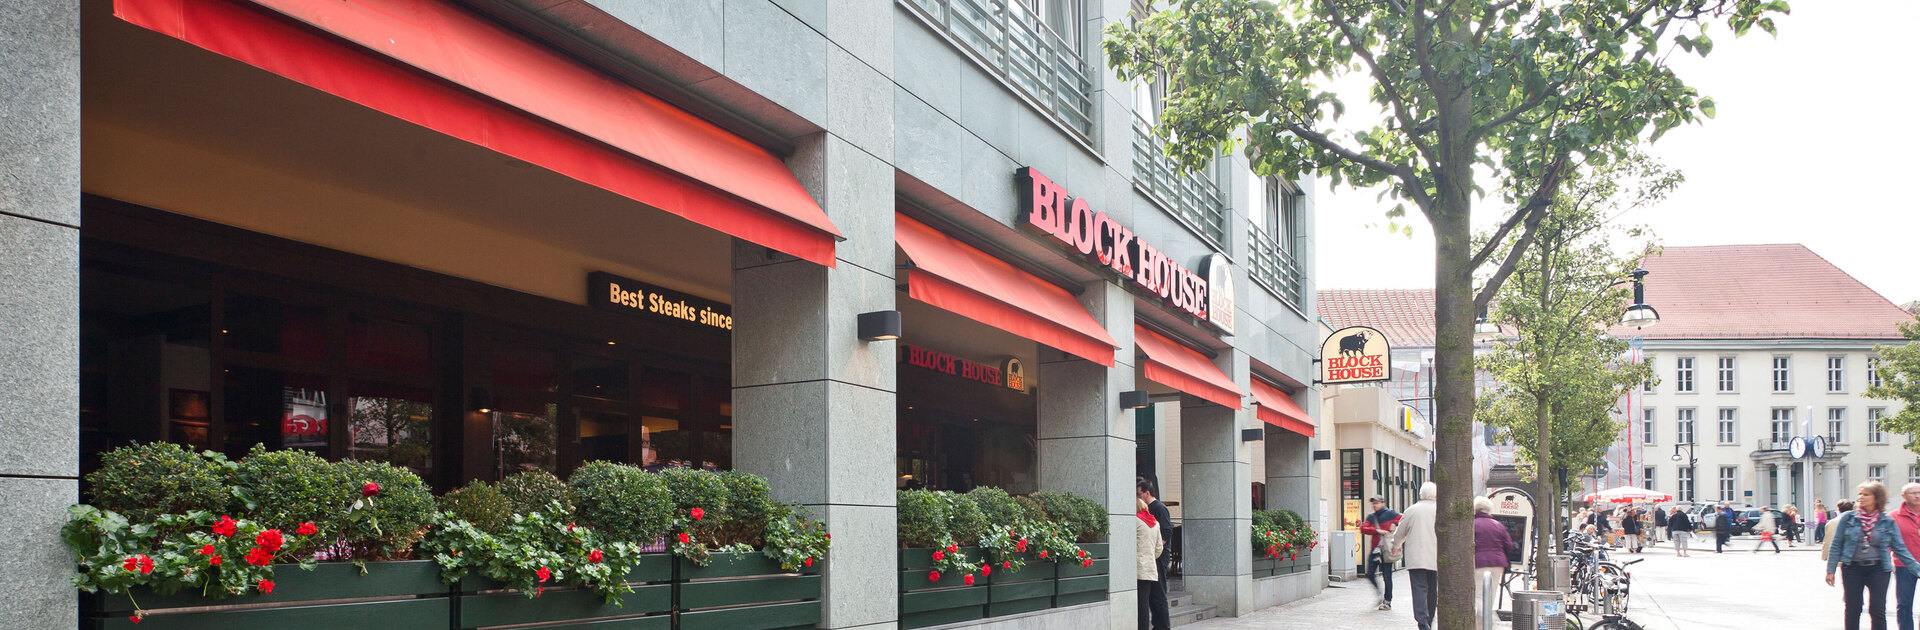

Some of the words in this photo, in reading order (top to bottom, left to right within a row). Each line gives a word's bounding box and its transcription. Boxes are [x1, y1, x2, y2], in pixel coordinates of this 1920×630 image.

[1029, 166, 1134, 280] BLOCK
[1136, 237, 1207, 321] HOUSE
[609, 282, 645, 310] Best
[648, 292, 697, 322] Steaks
[699, 306, 732, 331] since
[1211, 287, 1232, 315] BLOCK
[1211, 304, 1233, 330] HOUSE
[909, 345, 957, 376] BLOCK
[961, 359, 1003, 387] HOUSE
[1327, 354, 1383, 369] BLOCK
[1327, 366, 1383, 381] HOUSE
